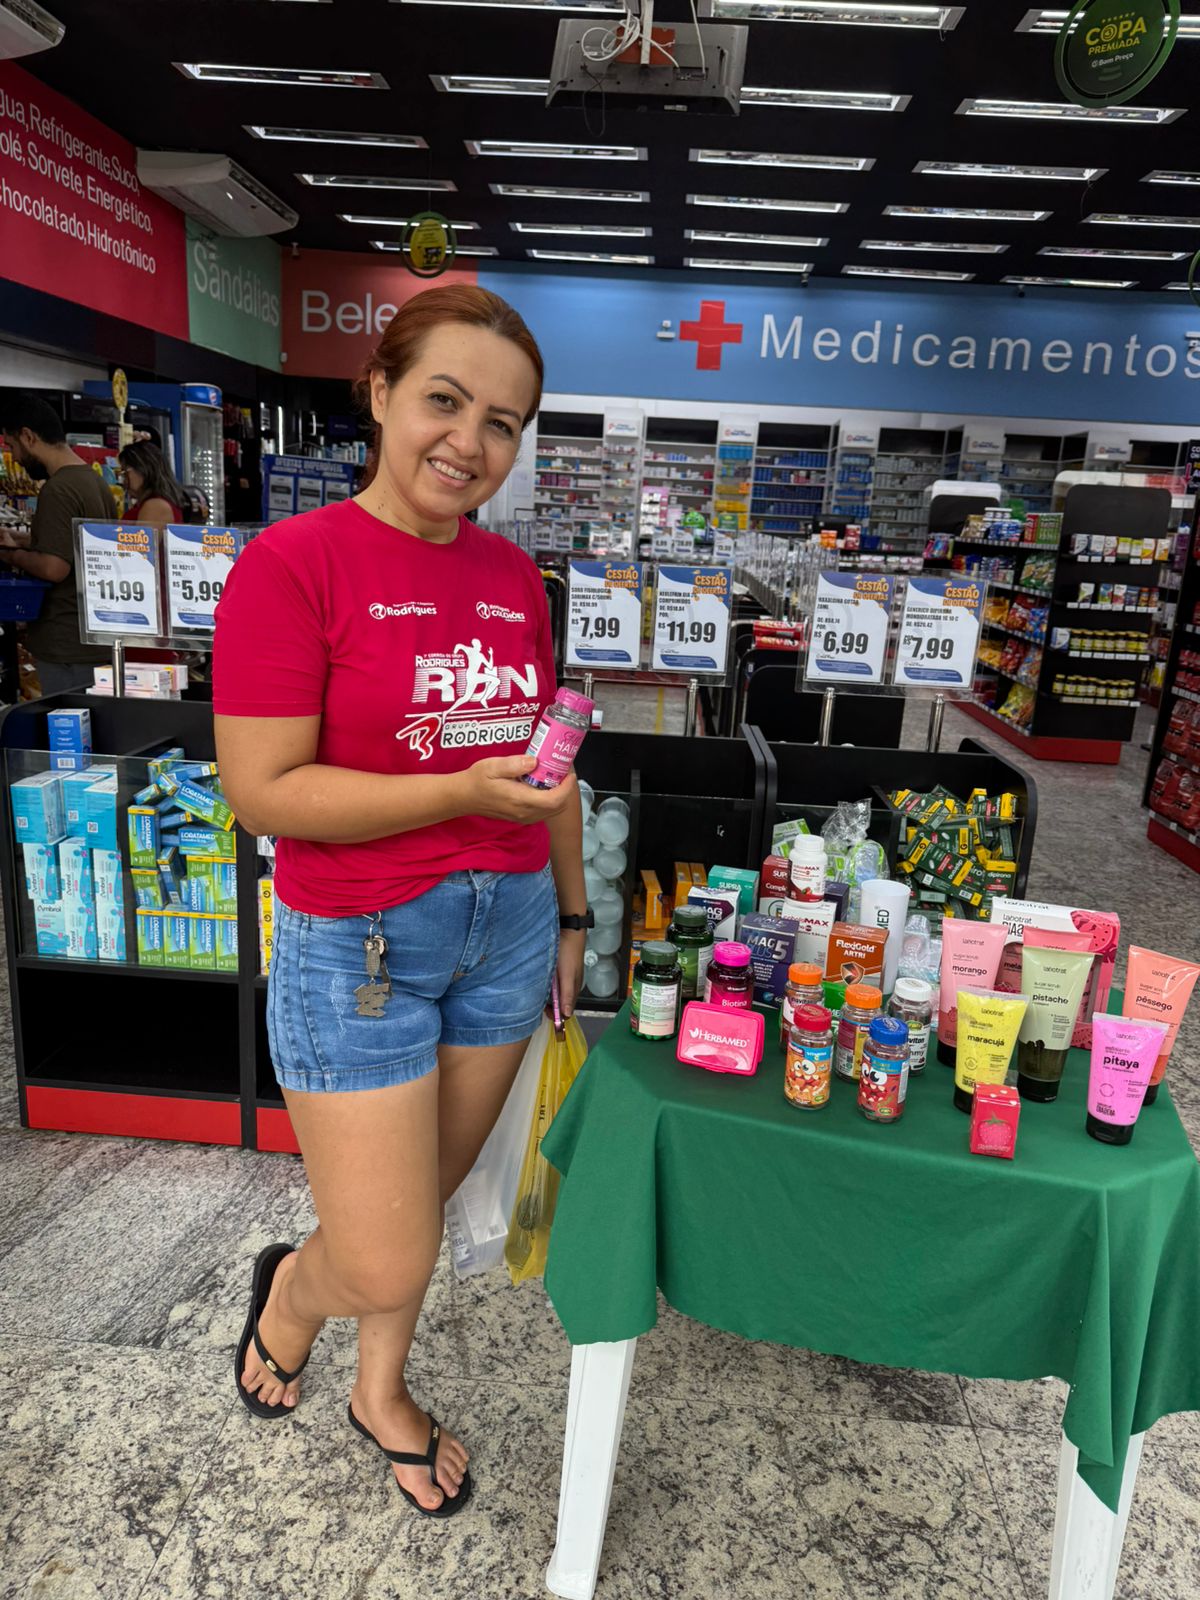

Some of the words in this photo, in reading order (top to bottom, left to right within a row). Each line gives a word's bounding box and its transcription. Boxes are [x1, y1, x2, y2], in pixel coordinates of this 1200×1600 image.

[1085, 16, 1147, 46] COPA
[1088, 37, 1140, 56] PREMIADA
[28, 141, 85, 199] Sorvete,
[87, 175, 153, 235] Energético,
[0, 177, 88, 245] hocolatado,
[87, 220, 156, 274] Hidrotônico
[193, 240, 279, 327] Sandálias
[760, 313, 1200, 379] Medicamentos
[117, 531, 149, 544] CESTÃO
[202, 532, 235, 546] CESTÃO
[605, 568, 639, 580] CESTÃO
[695, 575, 727, 586] CESTÃO
[96, 579, 144, 603] 11,99
[181, 580, 224, 603] 5,99
[856, 581, 889, 593] CESTÃO
[945, 587, 980, 600] CESTÃO
[386, 605, 437, 616] Rodrigues
[580, 617, 620, 640] 7,99
[666, 621, 716, 644] 11,99
[823, 631, 869, 655] 6,99
[911, 637, 954, 661] 7,99
[415, 655, 465, 668] RODRIGUES
[411, 664, 538, 703] RUN
[444, 722, 477, 731] GRUPO
[442, 724, 531, 746] RODRIGUES
[181, 832, 217, 841] LORATAMED
[718, 882, 742, 891] SUPRA
[746, 933, 776, 949] MAG
[772, 939, 790, 961] 5
[843, 949, 866, 959] ARTRI
[952, 965, 988, 976] morango
[1032, 993, 1069, 1005] pistache
[1135, 995, 1173, 1011] pêssego
[698, 1029, 748, 1048] HERBAMED
[967, 1034, 1005, 1047] maracujá
[1102, 1055, 1140, 1069] pitaya
